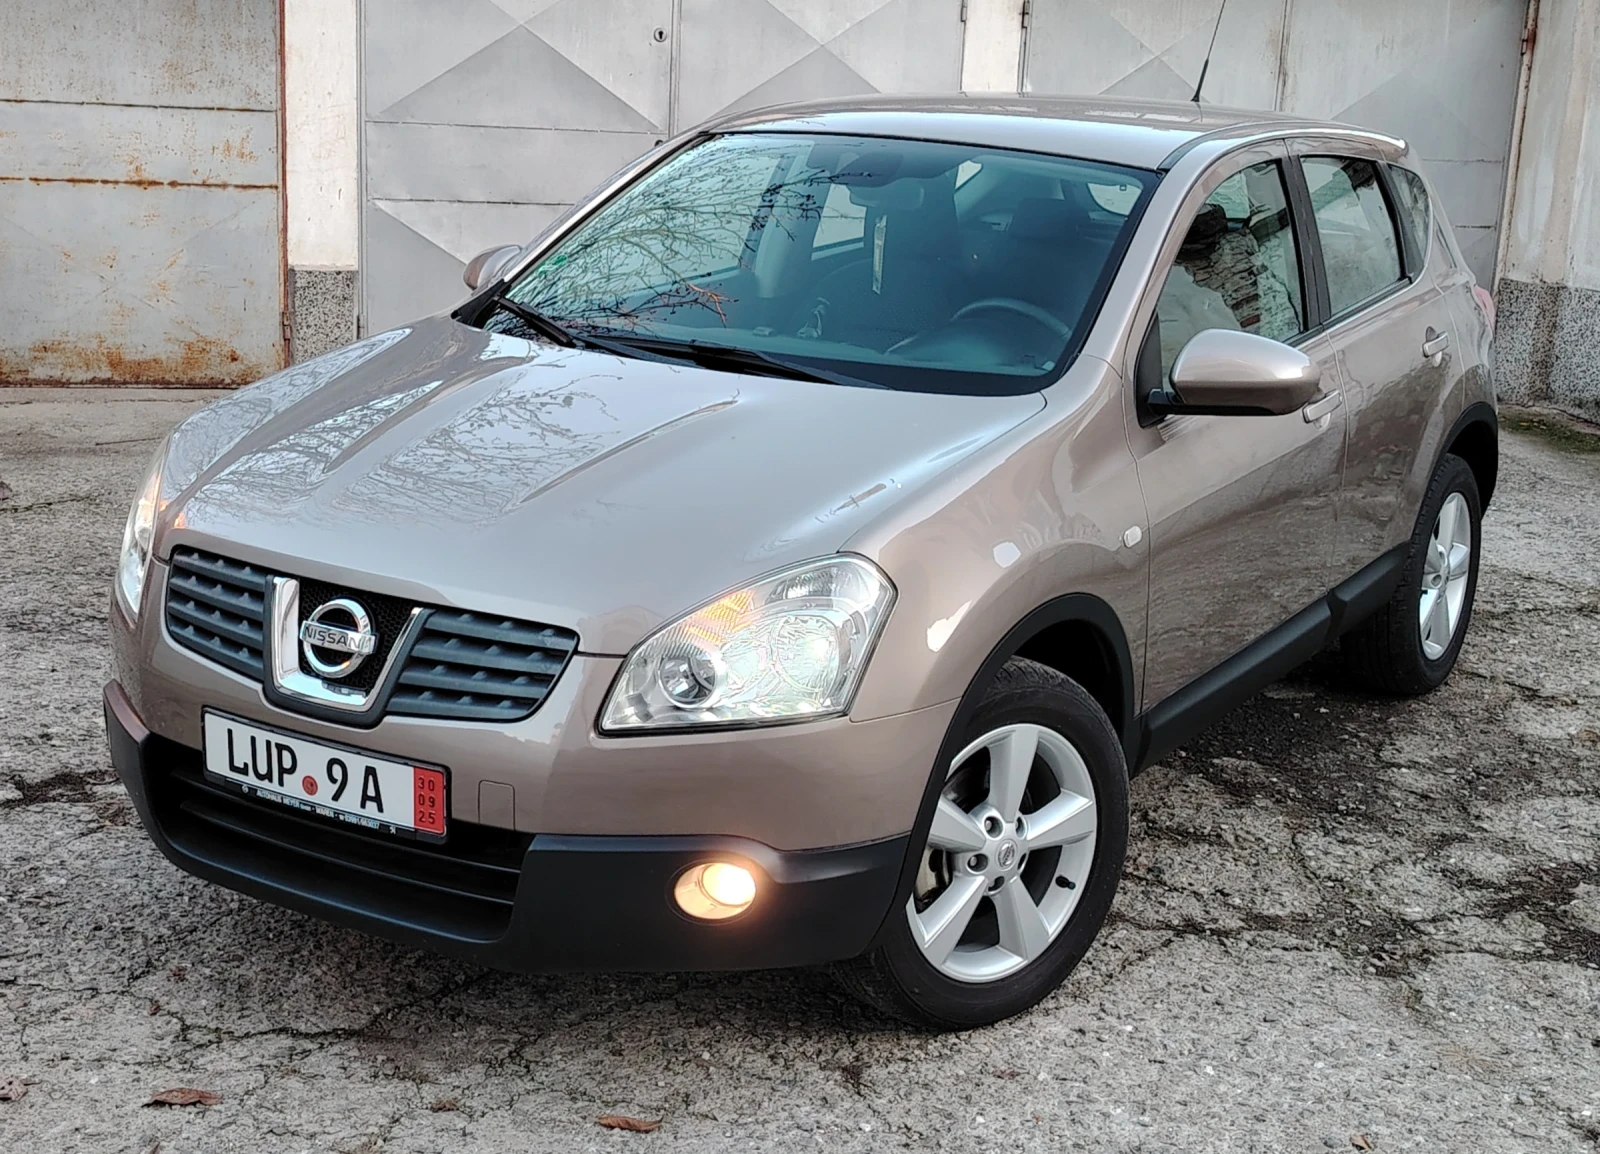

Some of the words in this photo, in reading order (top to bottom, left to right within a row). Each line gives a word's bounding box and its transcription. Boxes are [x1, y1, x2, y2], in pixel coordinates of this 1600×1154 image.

[304, 626, 360, 650] NISSAN
[227, 728, 298, 787] LUP
[326, 757, 349, 802] 9
[360, 765, 384, 813] A
[418, 776, 435, 791] 30
[418, 793, 435, 808] 09
[418, 810, 436, 825] 25
